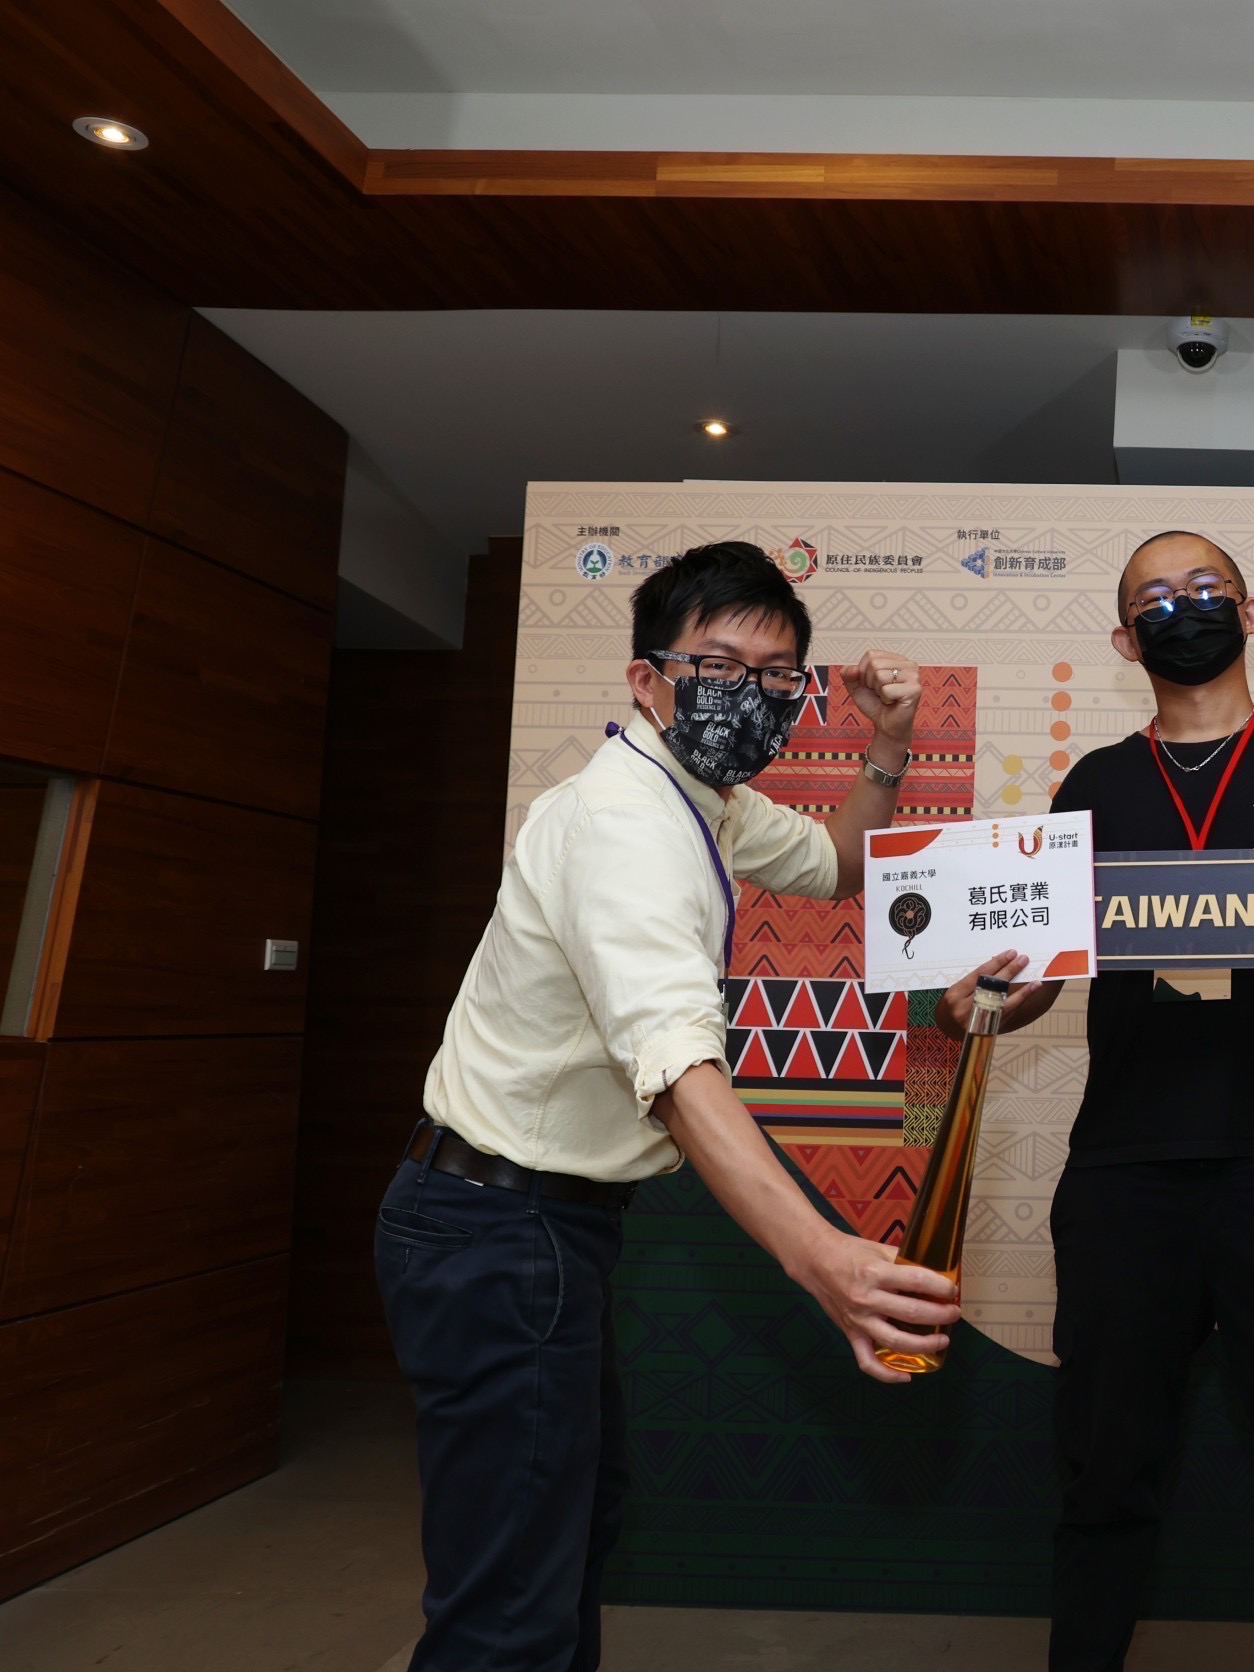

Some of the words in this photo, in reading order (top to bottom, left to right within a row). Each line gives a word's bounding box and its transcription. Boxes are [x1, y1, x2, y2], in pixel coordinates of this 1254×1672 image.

[577, 526, 620, 537] 主辦機關
[957, 529, 1000, 540] 執行單位
[825, 554, 923, 566] 原住民族委員會
[994, 556, 1066, 570] 創新育成部
[706, 721, 731, 738] BLACK
[1049, 832, 1078, 841] U-start
[1048, 840, 1079, 850] 原漾計畫
[882, 868, 937, 882] 國立嘉義大學
[968, 881, 1050, 906] 葛氏實業
[968, 906, 1049, 931] 有限公司
